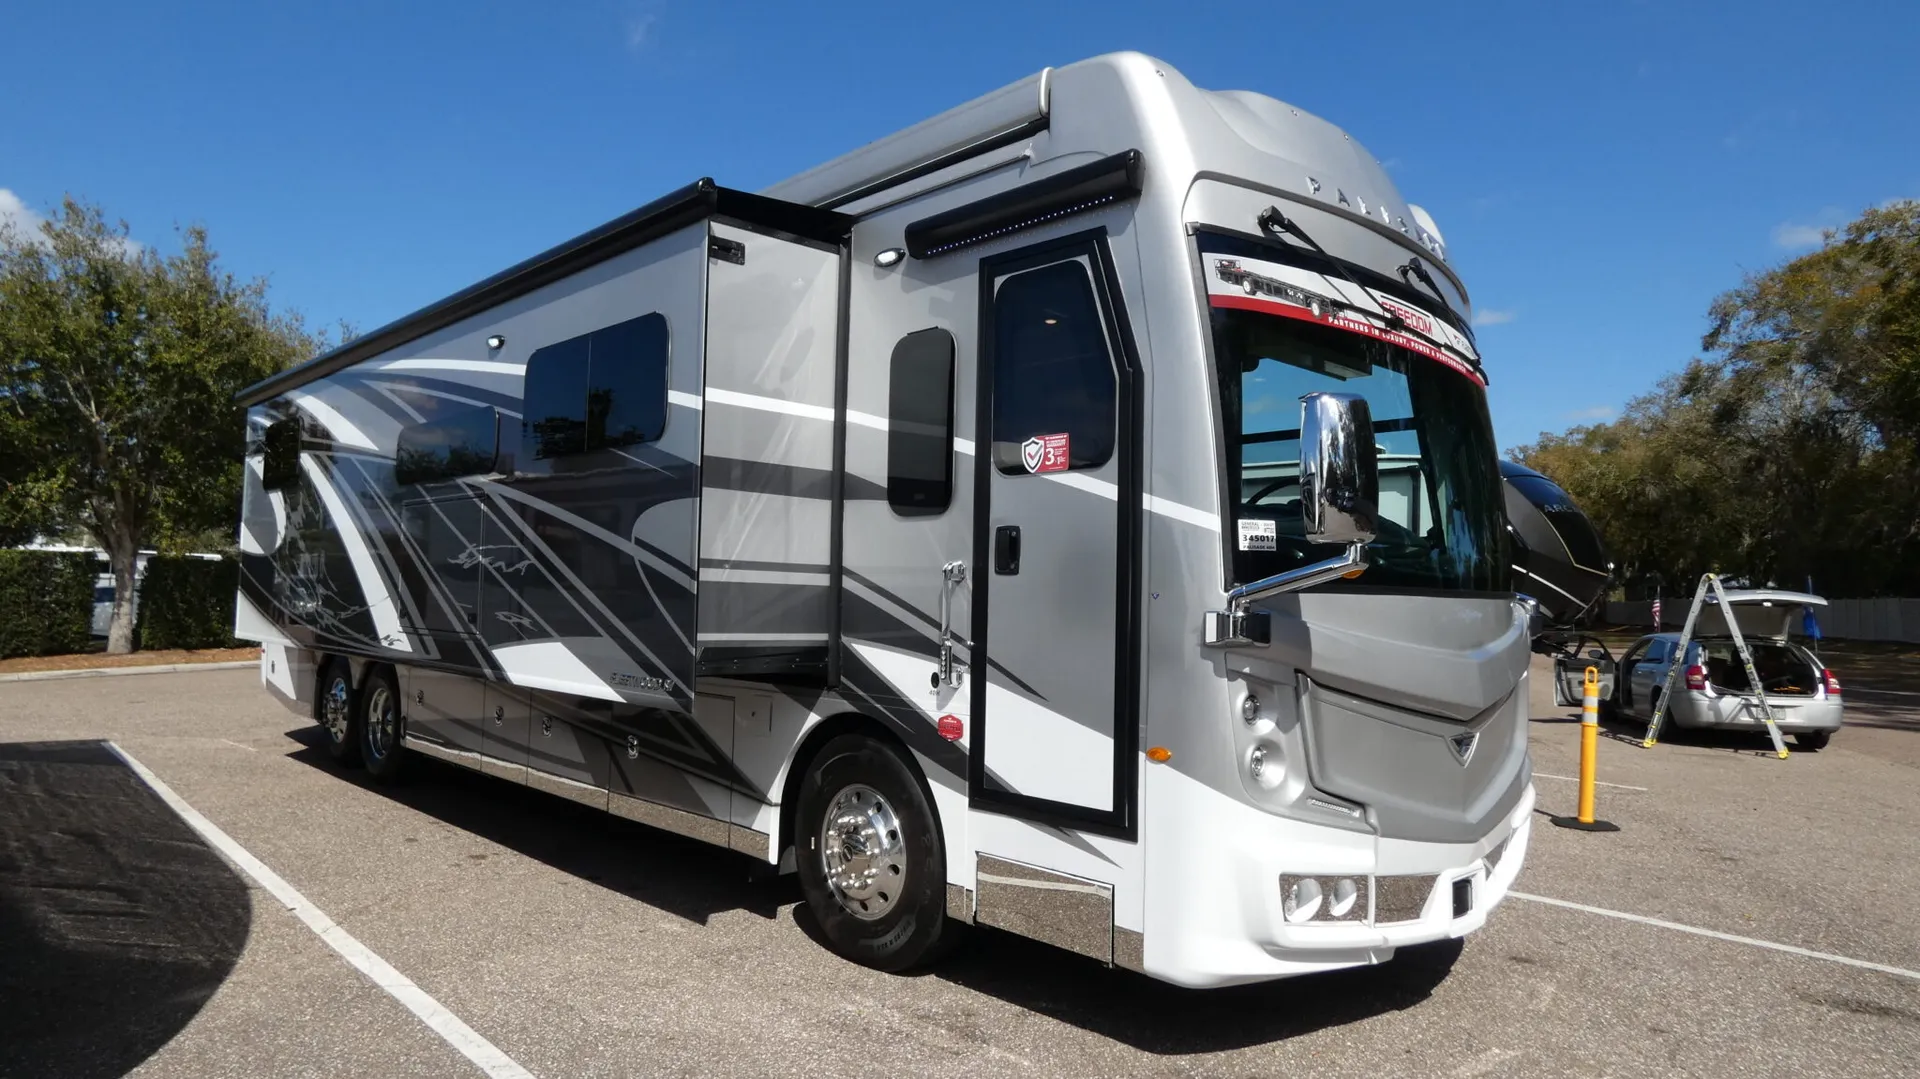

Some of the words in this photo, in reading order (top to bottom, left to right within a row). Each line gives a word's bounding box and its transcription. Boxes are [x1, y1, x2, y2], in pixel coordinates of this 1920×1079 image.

[1381, 301, 1434, 338] FREEDOM
[1328, 317, 1369, 333] PARTNERS
[1371, 327, 1380, 336] IN
[1382, 331, 1409, 347] LUXURY,
[1411, 340, 1431, 355] POWER
[1045, 447, 1055, 465] 3
[1242, 534, 1275, 543] 345017
